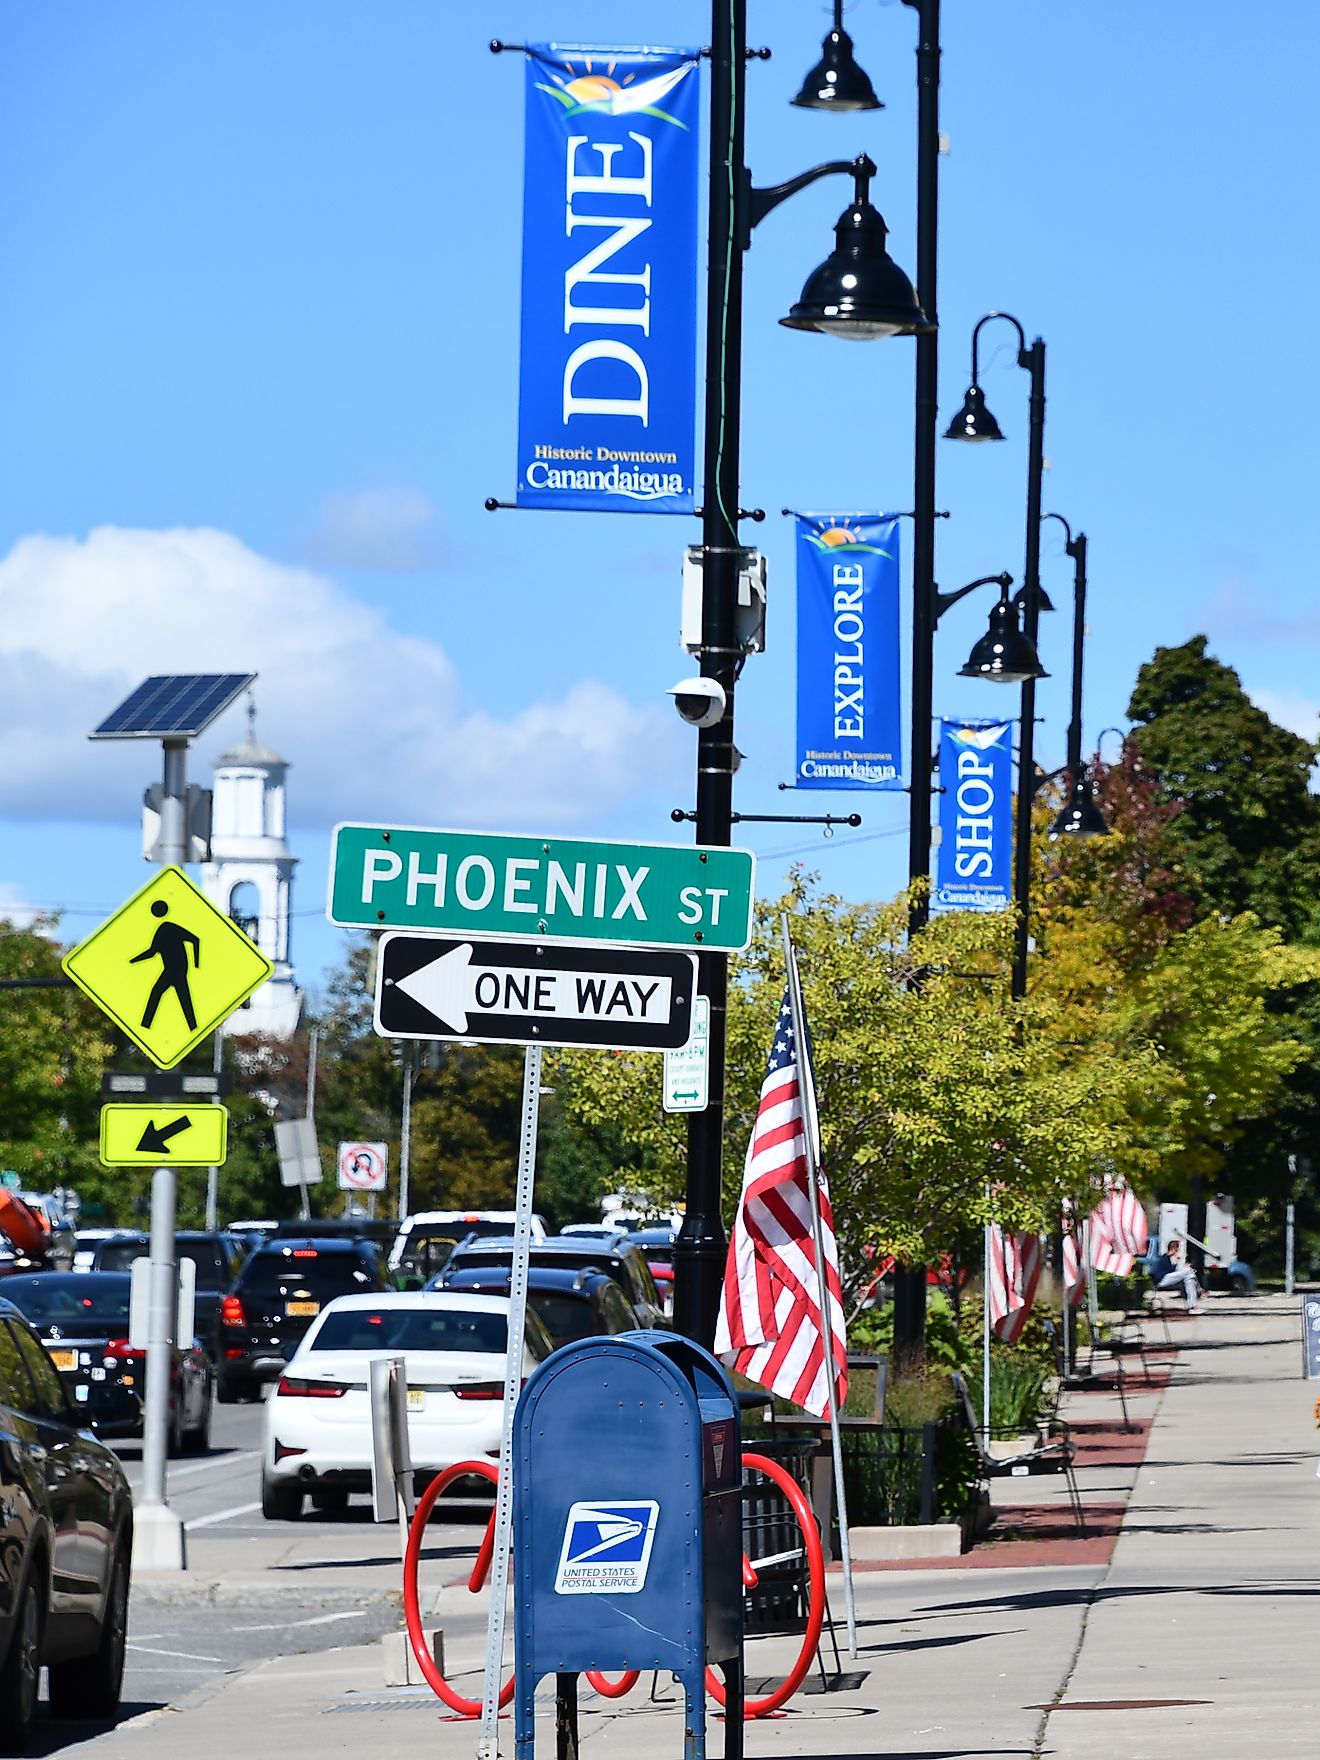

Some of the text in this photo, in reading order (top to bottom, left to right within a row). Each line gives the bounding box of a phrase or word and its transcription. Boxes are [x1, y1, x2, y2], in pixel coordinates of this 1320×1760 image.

[563, 130, 653, 428] DINE
[535, 444, 678, 464] Historic Downtown
[526, 461, 685, 496] Canandaigua
[833, 563, 865, 740] EXPLORE
[800, 760, 896, 780] Canandaigua
[954, 750, 995, 878] SHOP
[361, 848, 730, 926] PHOENIX ST
[474, 972, 661, 1018] ONE WAY
[561, 1578, 638, 1588] POSTAL SERVICE
[563, 1567, 636, 1577] UNITED STATES
